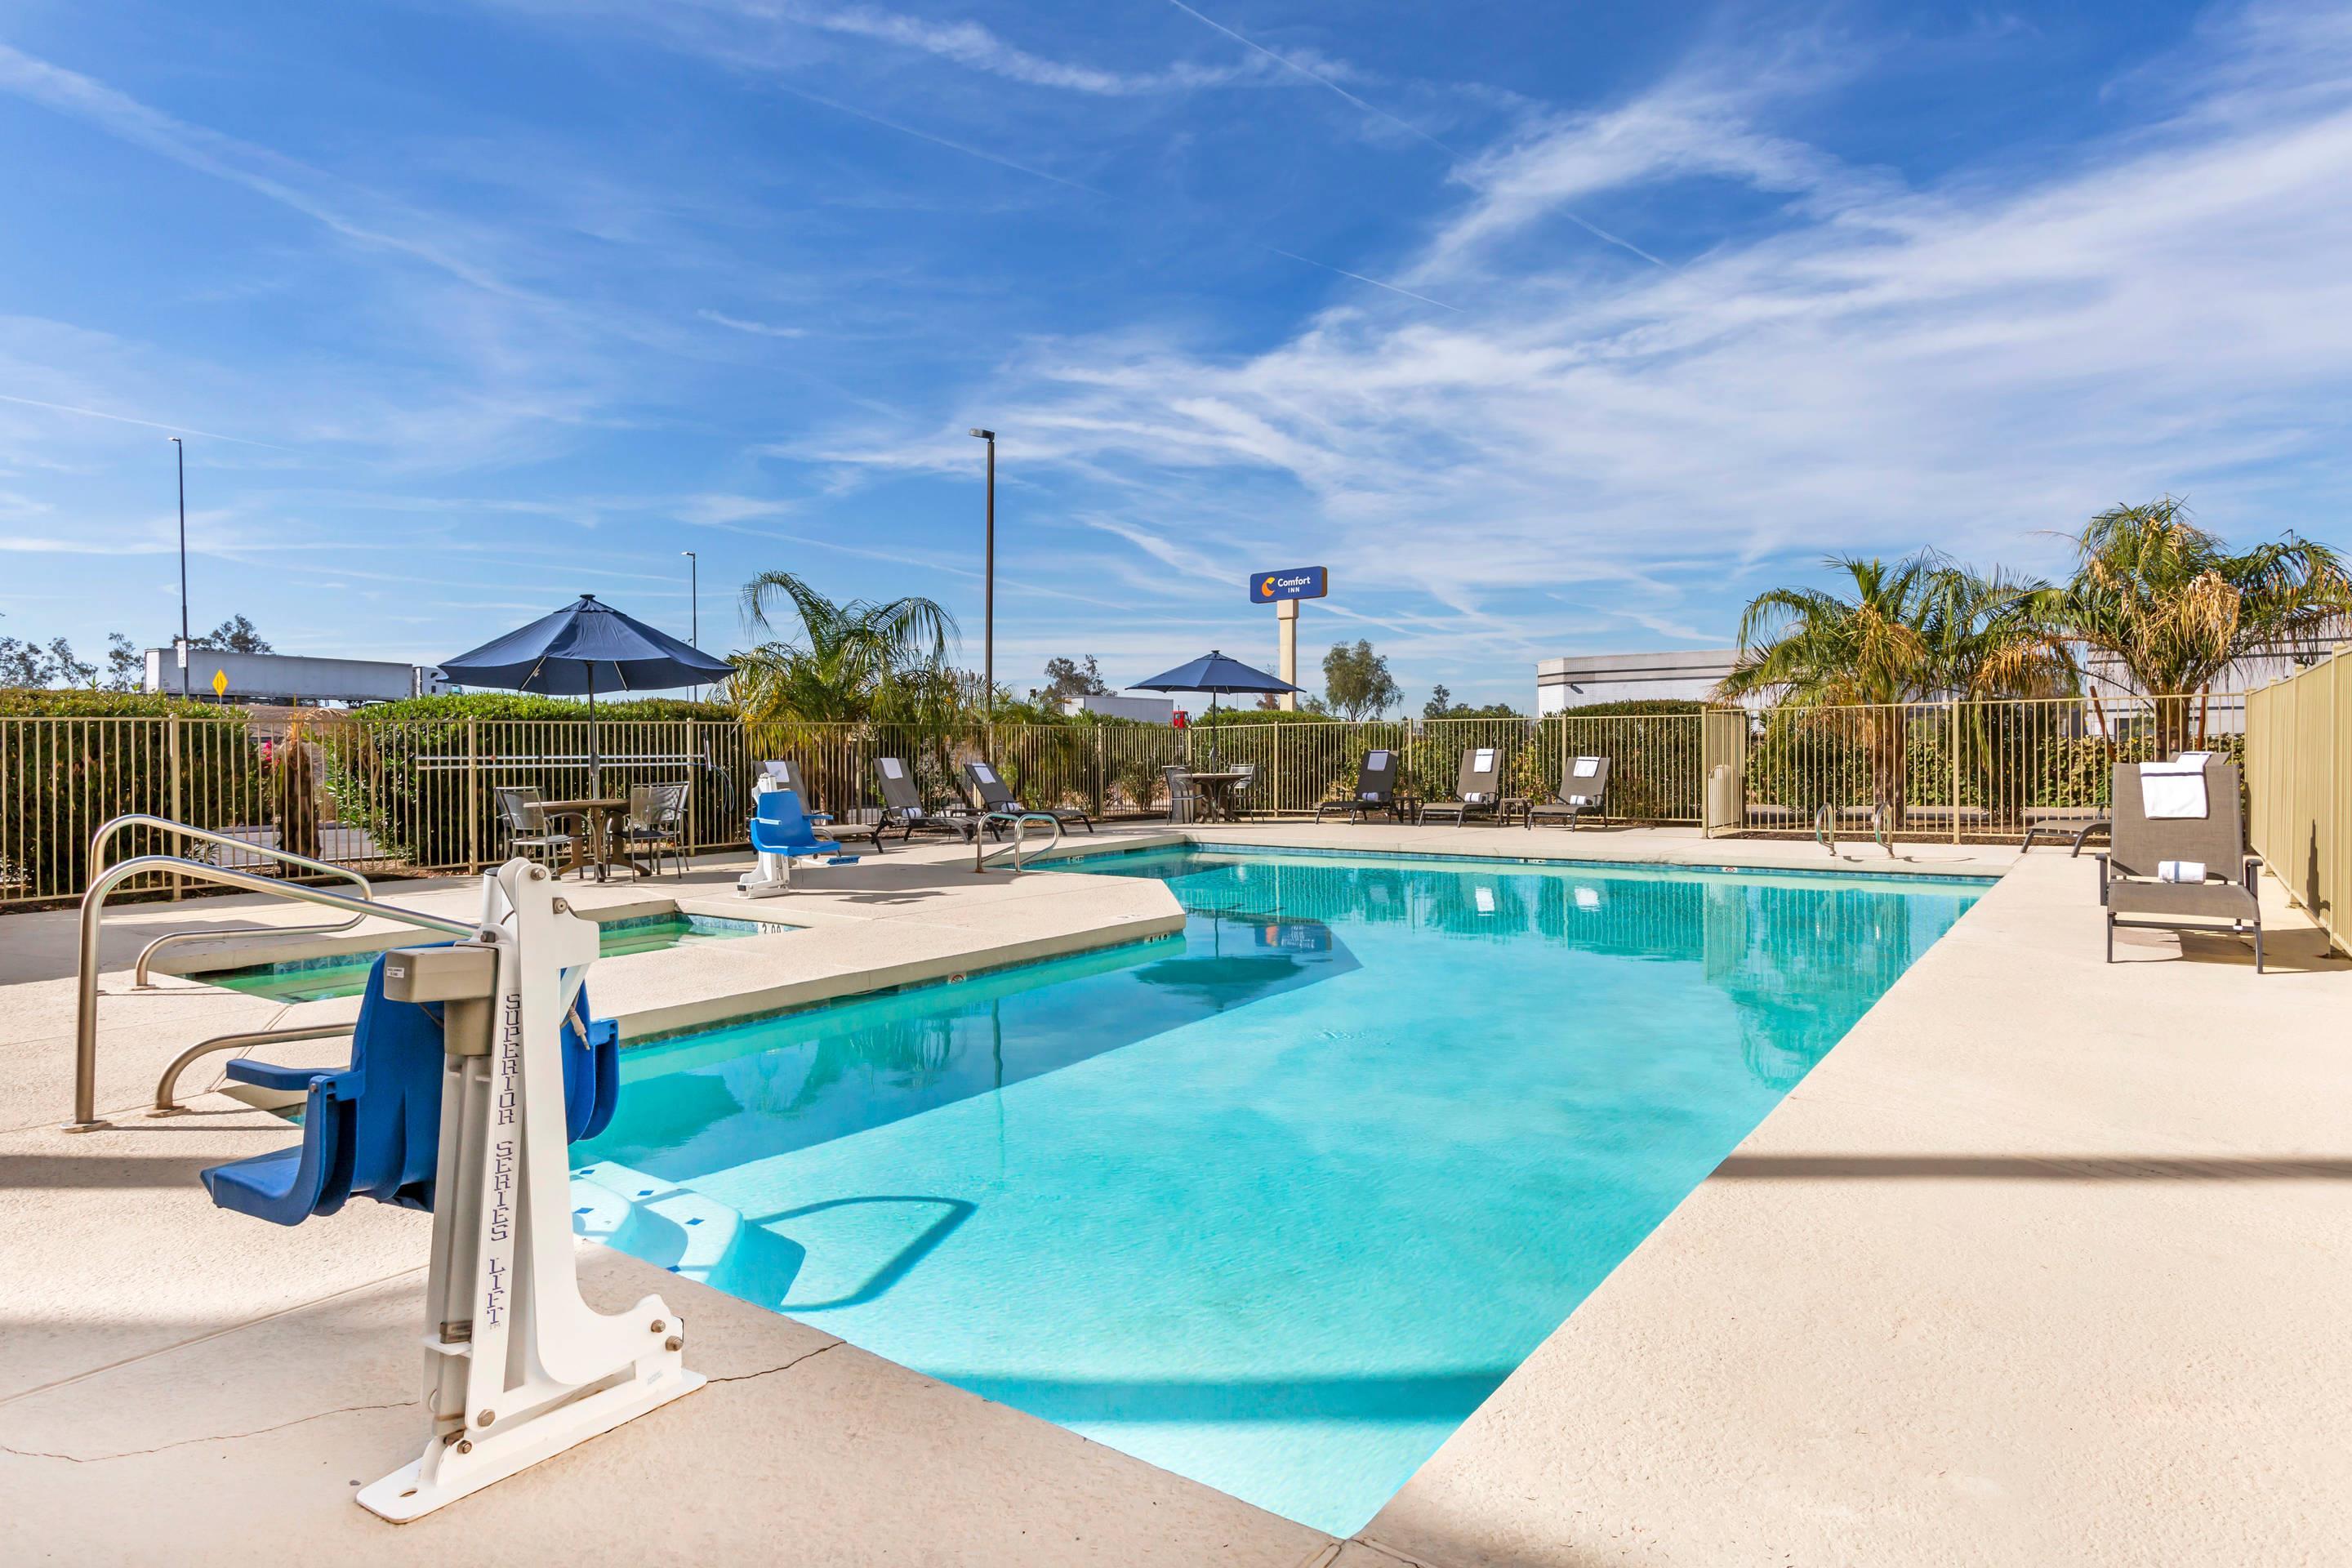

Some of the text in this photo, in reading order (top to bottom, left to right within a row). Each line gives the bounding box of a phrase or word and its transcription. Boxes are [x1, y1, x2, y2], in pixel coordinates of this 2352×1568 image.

[1277, 577, 1311, 587] Comfort
[487, 994, 521, 1325] SUPERIOR SERIES LIFT
